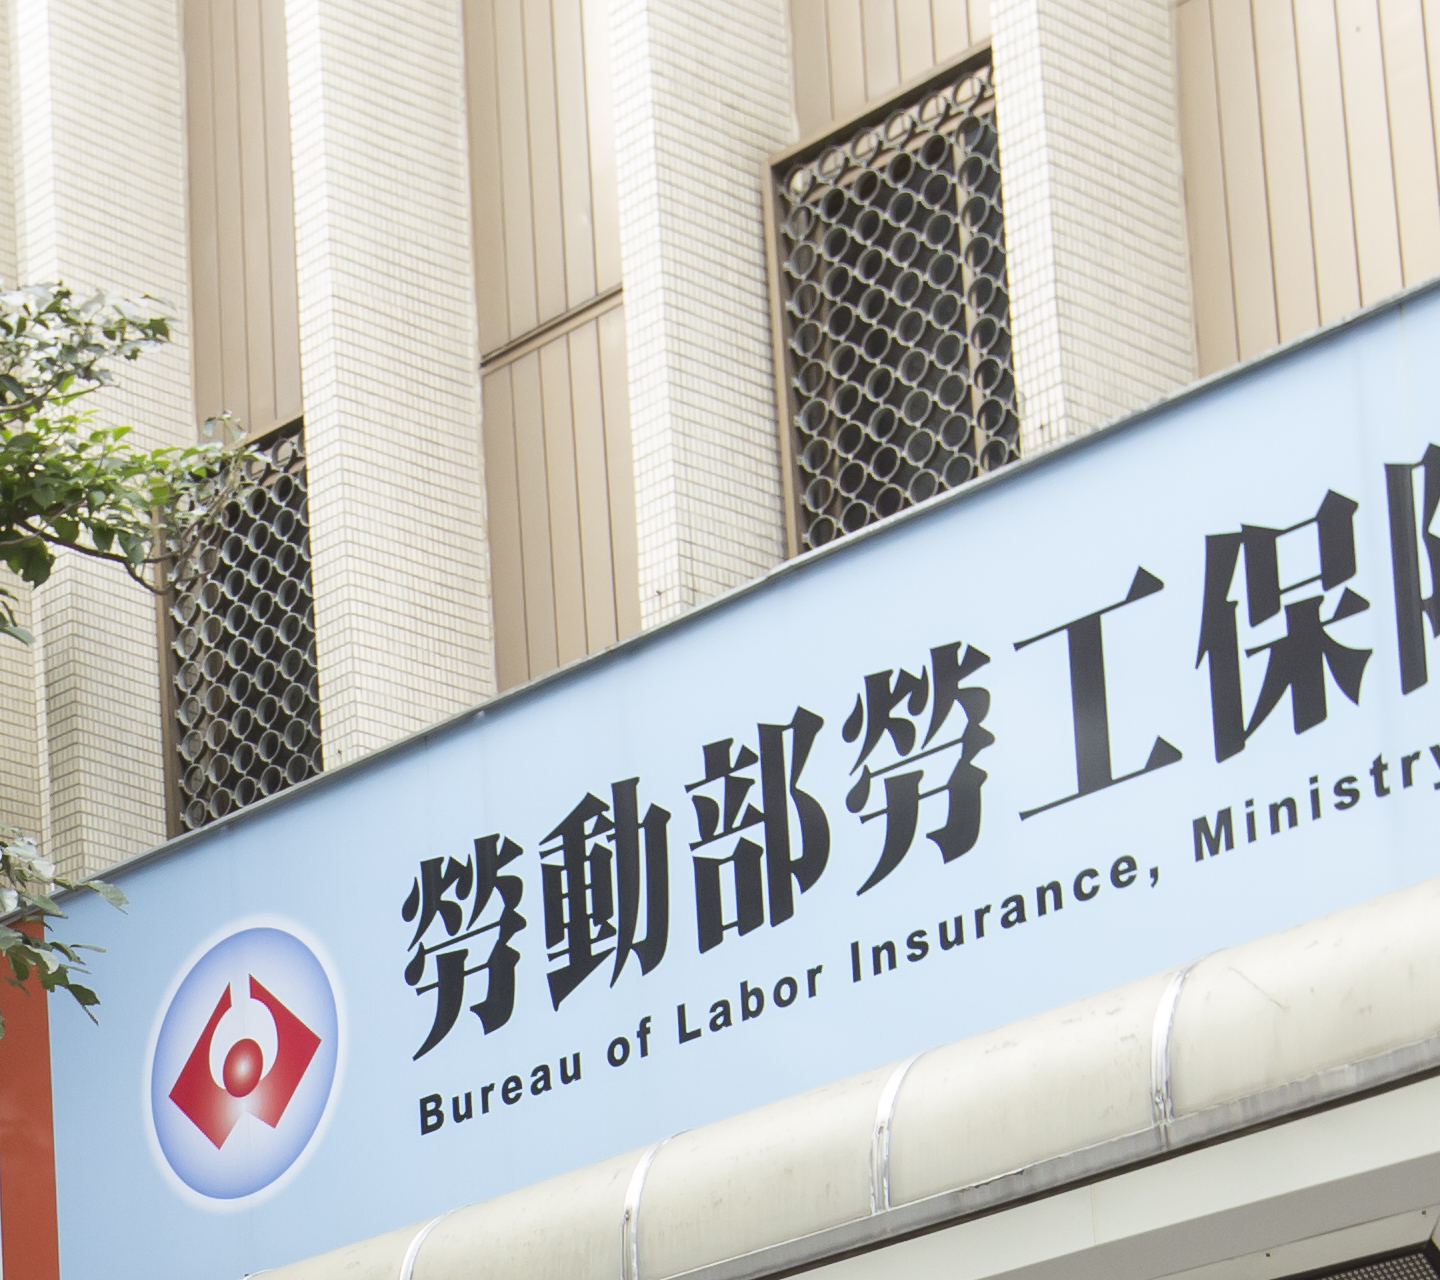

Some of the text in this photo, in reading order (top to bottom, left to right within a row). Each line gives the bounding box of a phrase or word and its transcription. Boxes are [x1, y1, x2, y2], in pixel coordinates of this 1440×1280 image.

[418, 1045, 584, 1138] Bureau
[603, 1015, 655, 1071] of
[675, 960, 825, 1044] Labor
[848, 852, 1163, 985] Insurance,
